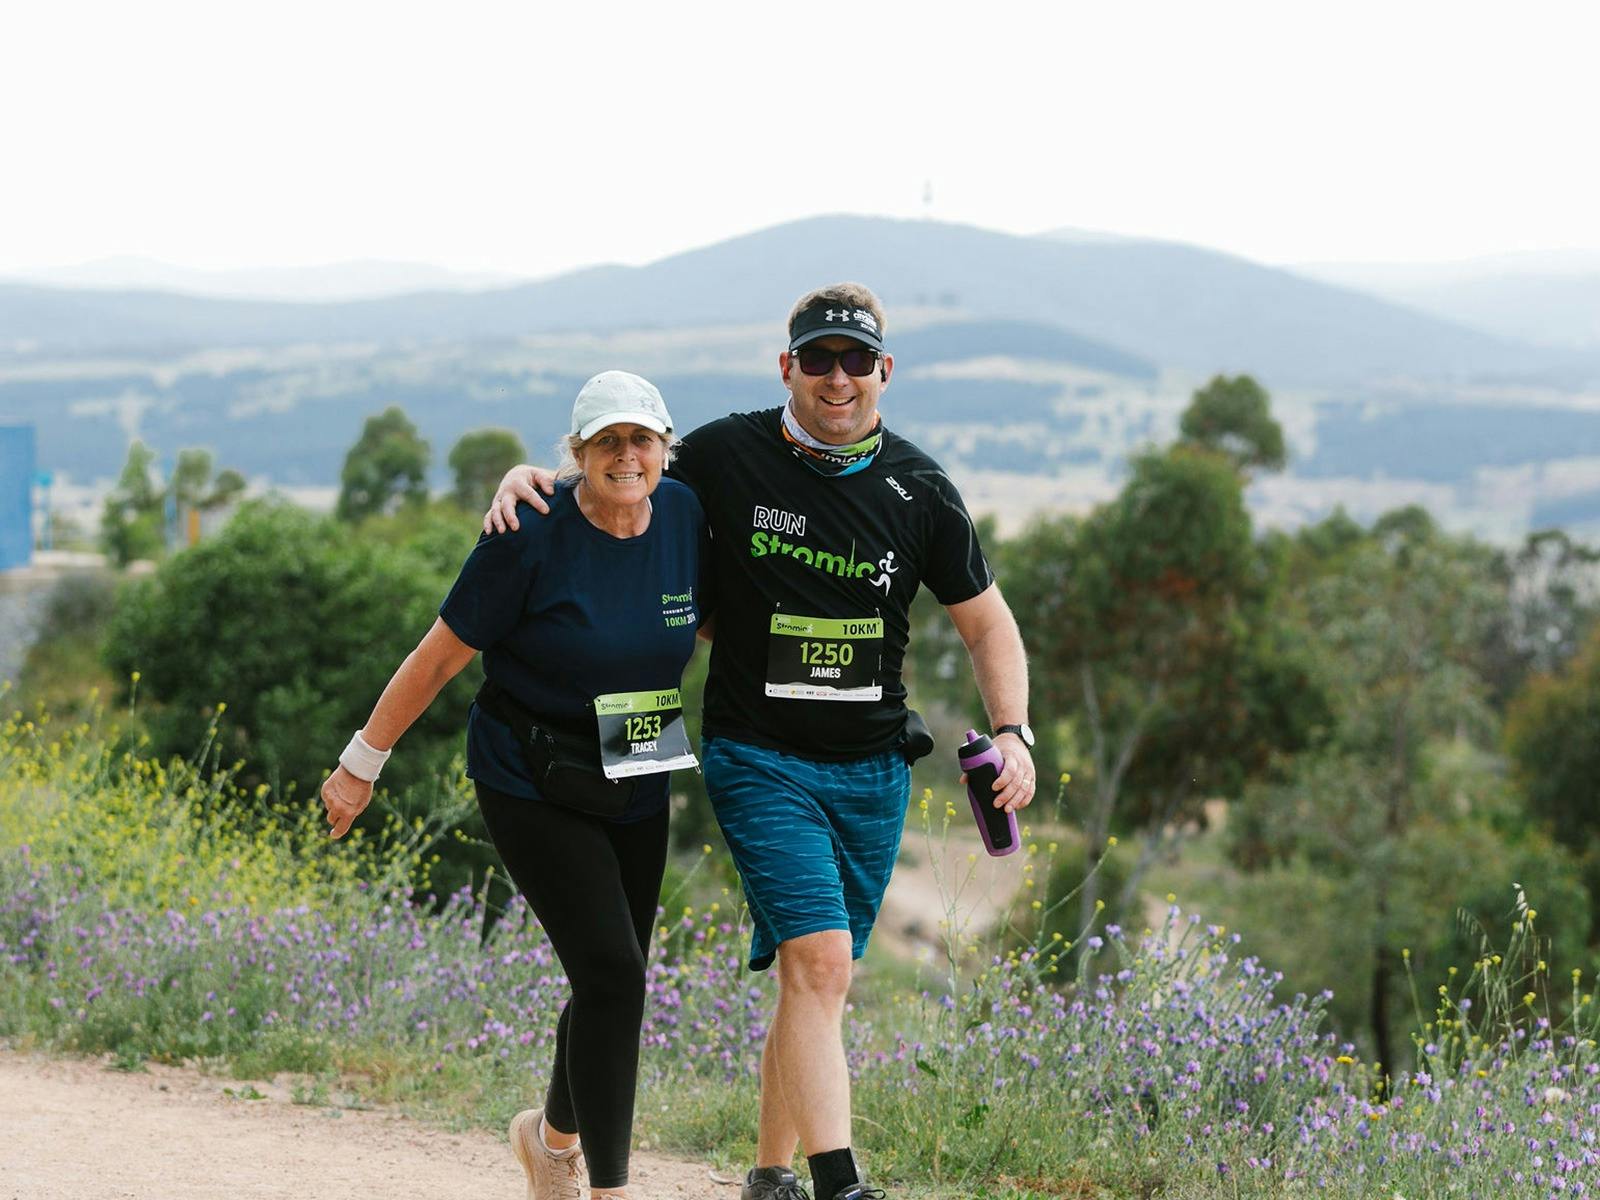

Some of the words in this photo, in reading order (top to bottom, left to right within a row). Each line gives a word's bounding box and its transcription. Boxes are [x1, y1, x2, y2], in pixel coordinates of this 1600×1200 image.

[885, 476, 913, 501] 2XU
[753, 505, 806, 537] RUN
[665, 615, 687, 627] 10KM
[842, 623, 877, 636] 10KM
[800, 641, 854, 666] 1250
[810, 666, 841, 679] JAMES
[656, 693, 679, 707] 10KM
[625, 715, 661, 741] 1253
[630, 741, 658, 755] TRACEY
